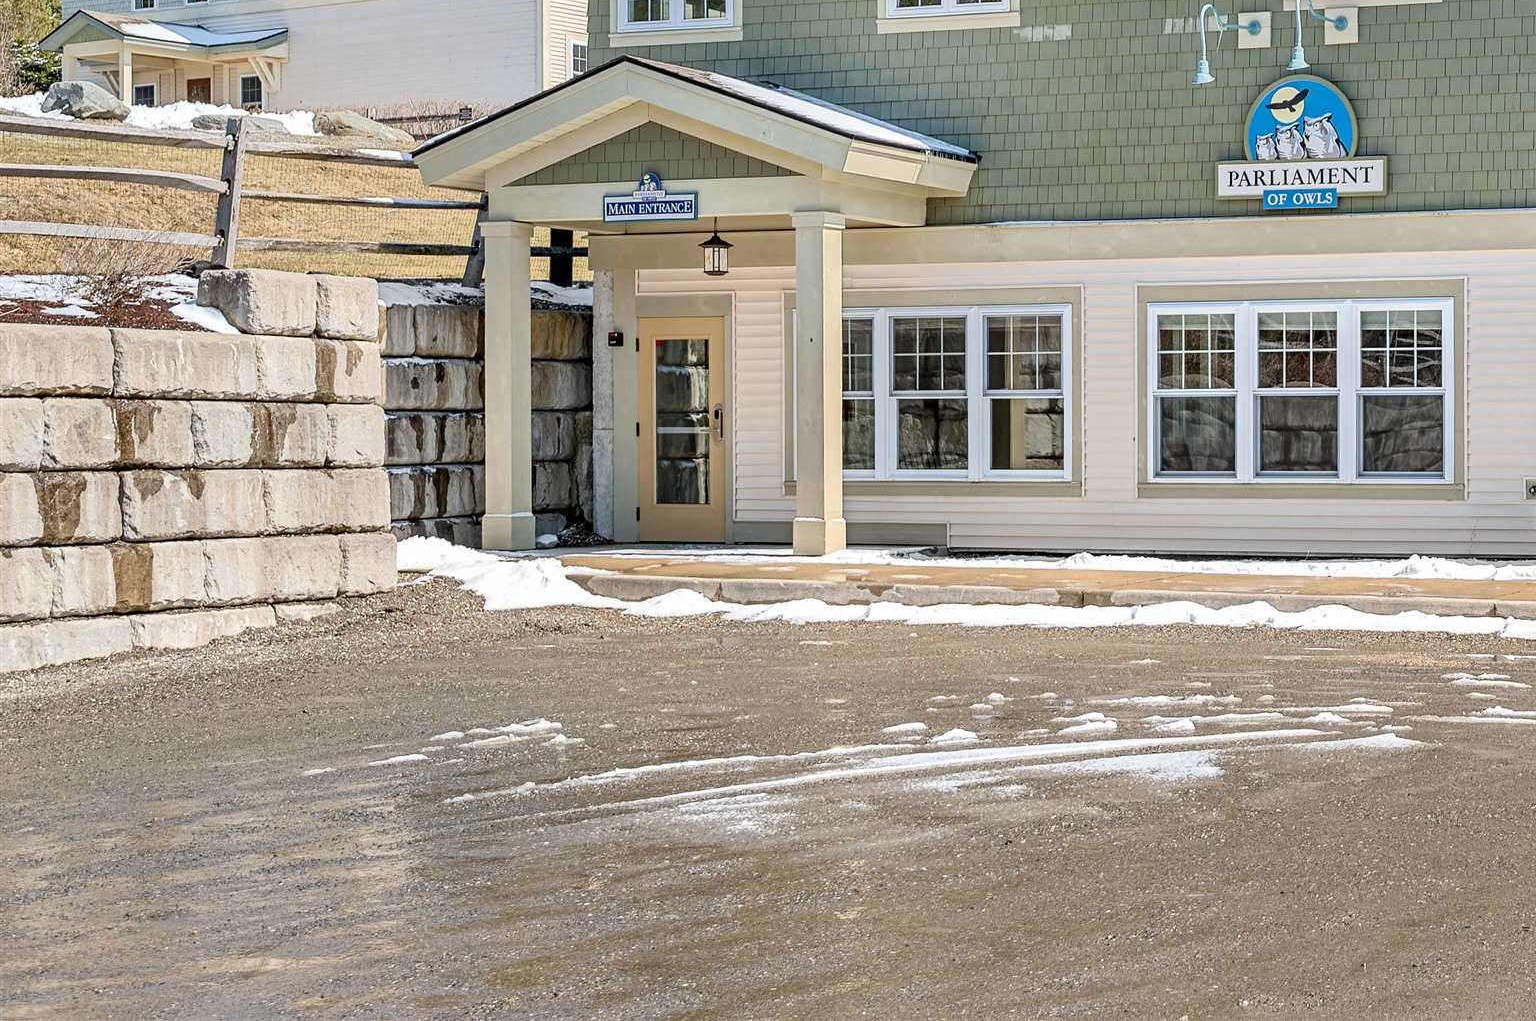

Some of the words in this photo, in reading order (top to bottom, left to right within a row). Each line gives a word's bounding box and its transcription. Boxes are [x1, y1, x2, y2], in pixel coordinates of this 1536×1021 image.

[1228, 166, 1373, 187] PARLIAMENT
[1267, 194, 1287, 205] OF
[1293, 192, 1333, 205] OWLS
[608, 203, 636, 215] MAIN
[639, 201, 691, 214] ENTRANCE
